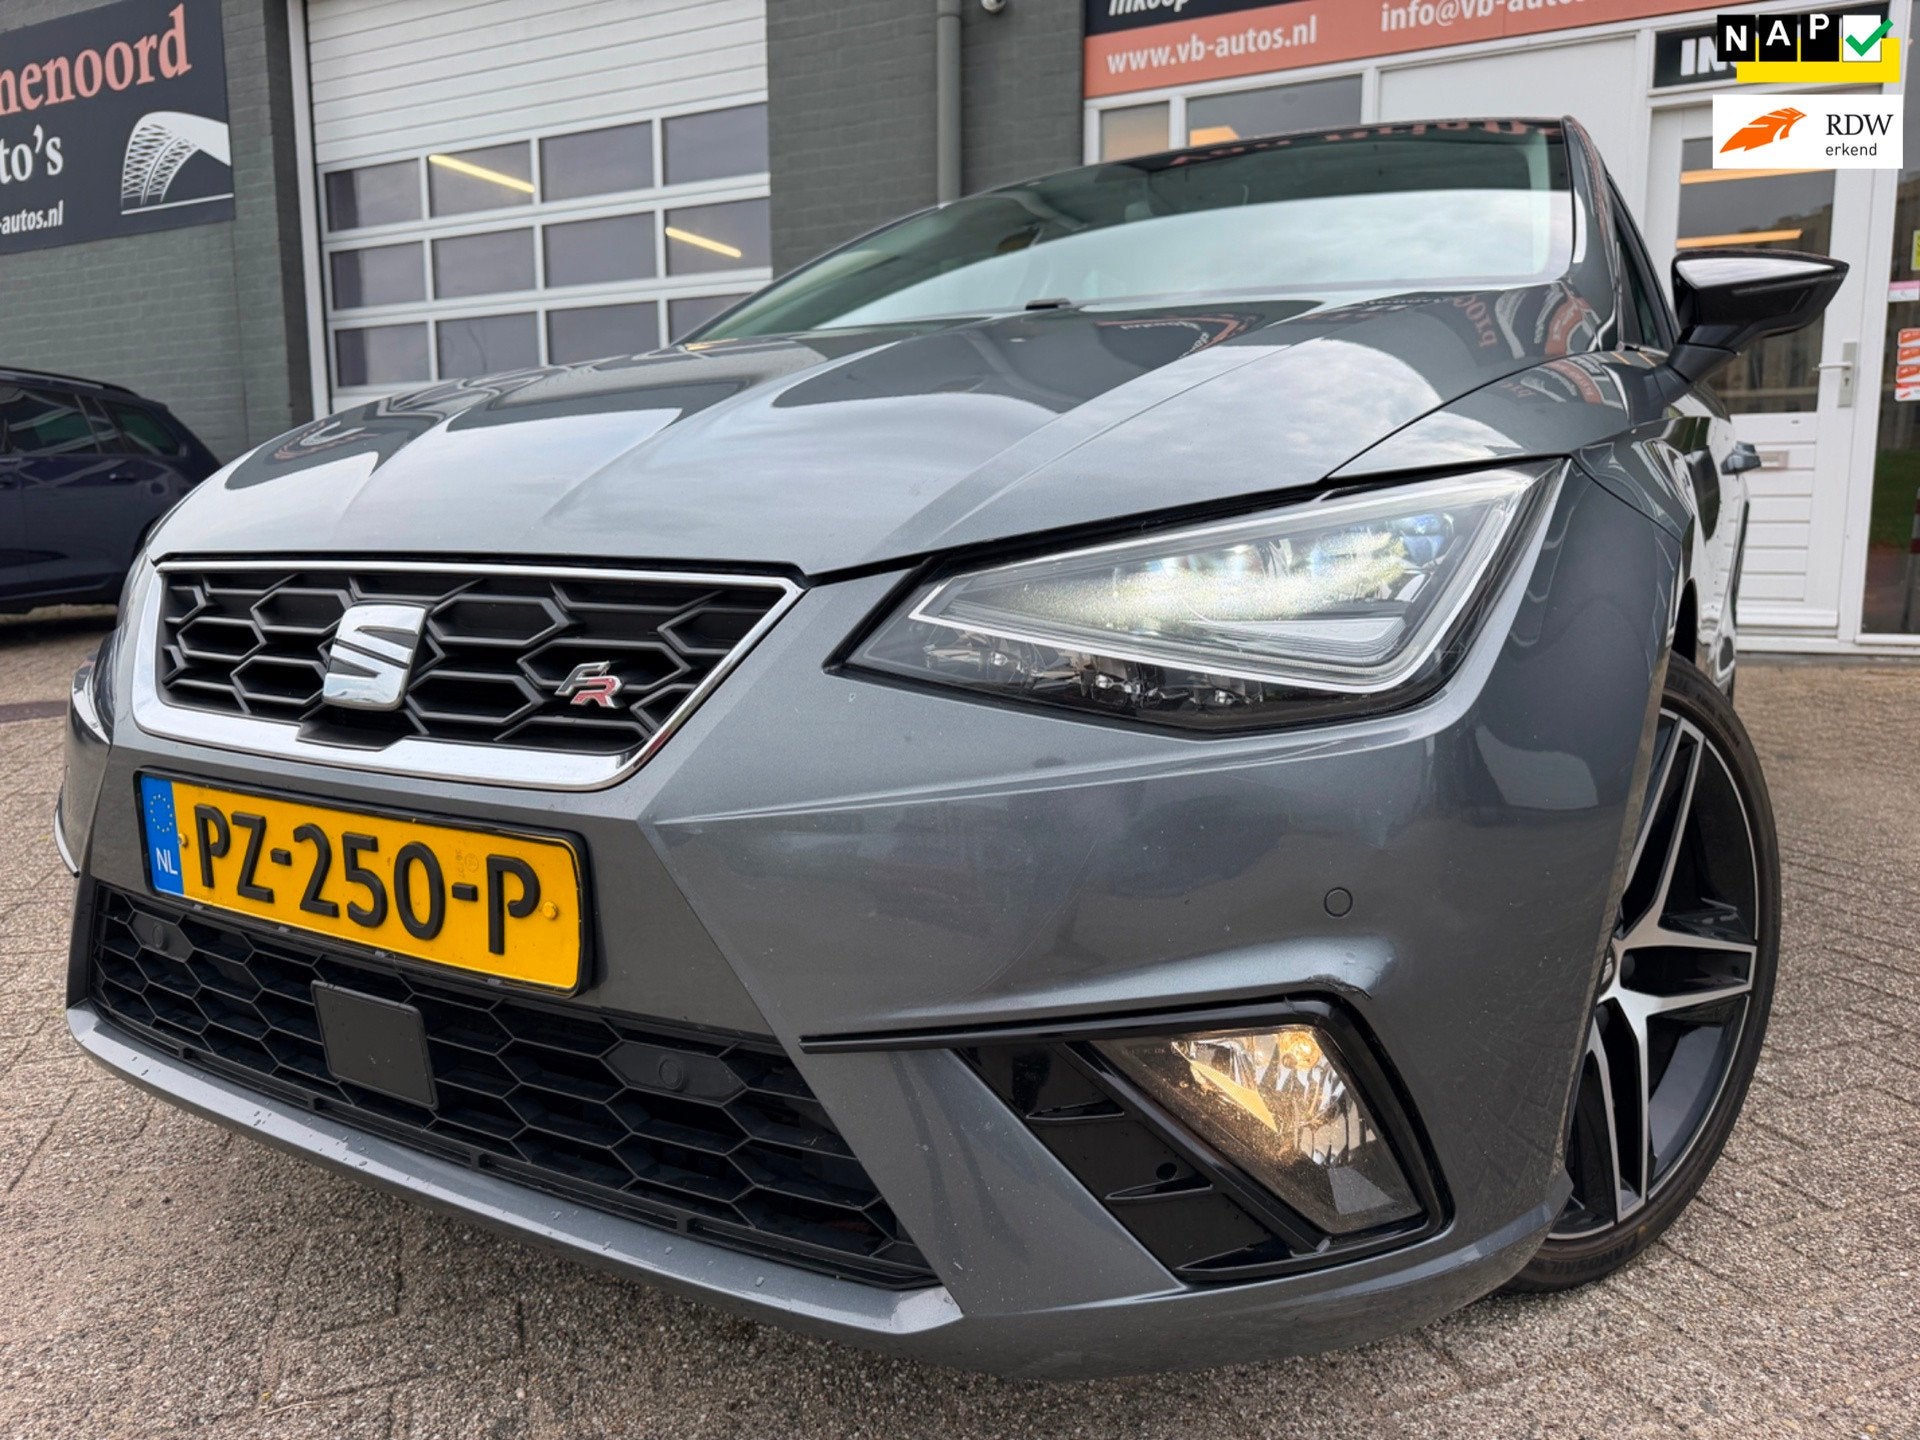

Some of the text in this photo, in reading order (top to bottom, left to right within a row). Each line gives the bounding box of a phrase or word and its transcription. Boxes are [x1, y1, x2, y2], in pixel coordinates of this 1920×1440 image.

[1107, 15, 1318, 74] www.vb-autos.nl
[155, 847, 179, 876] NL
[194, 804, 541, 956] PZ-250-P
